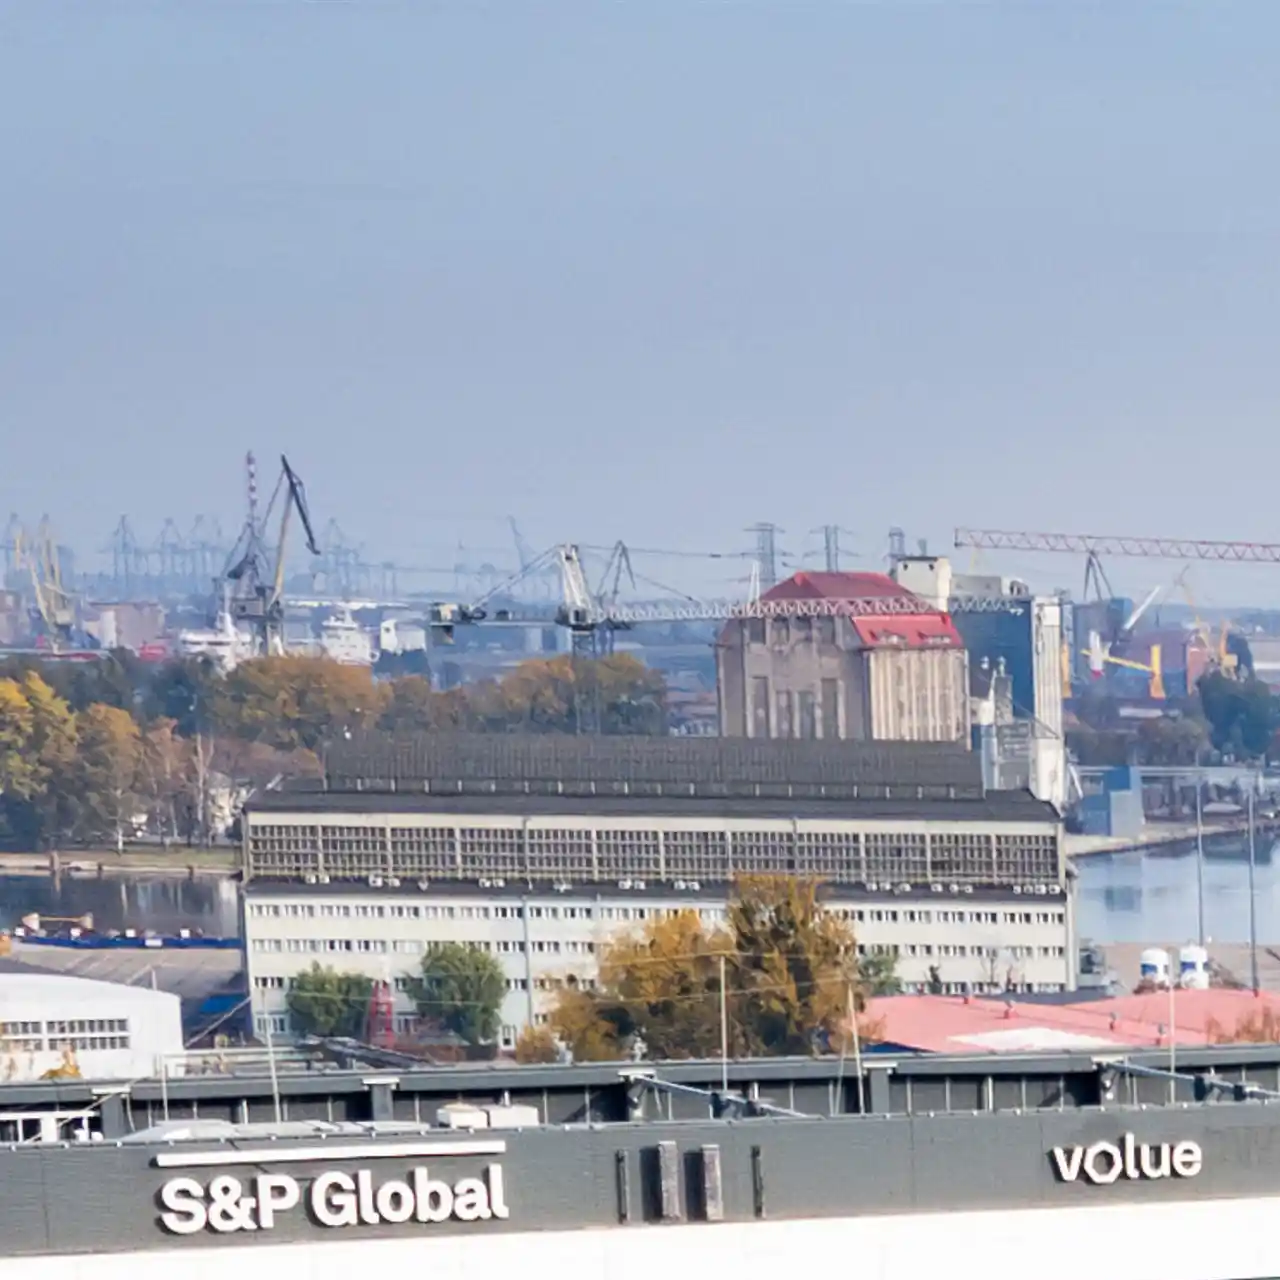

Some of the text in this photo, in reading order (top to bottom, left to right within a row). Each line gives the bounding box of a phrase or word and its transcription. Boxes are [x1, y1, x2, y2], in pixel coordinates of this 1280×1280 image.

[1052, 1131, 1202, 1184] volue
[160, 1163, 509, 1234] S&P Global
